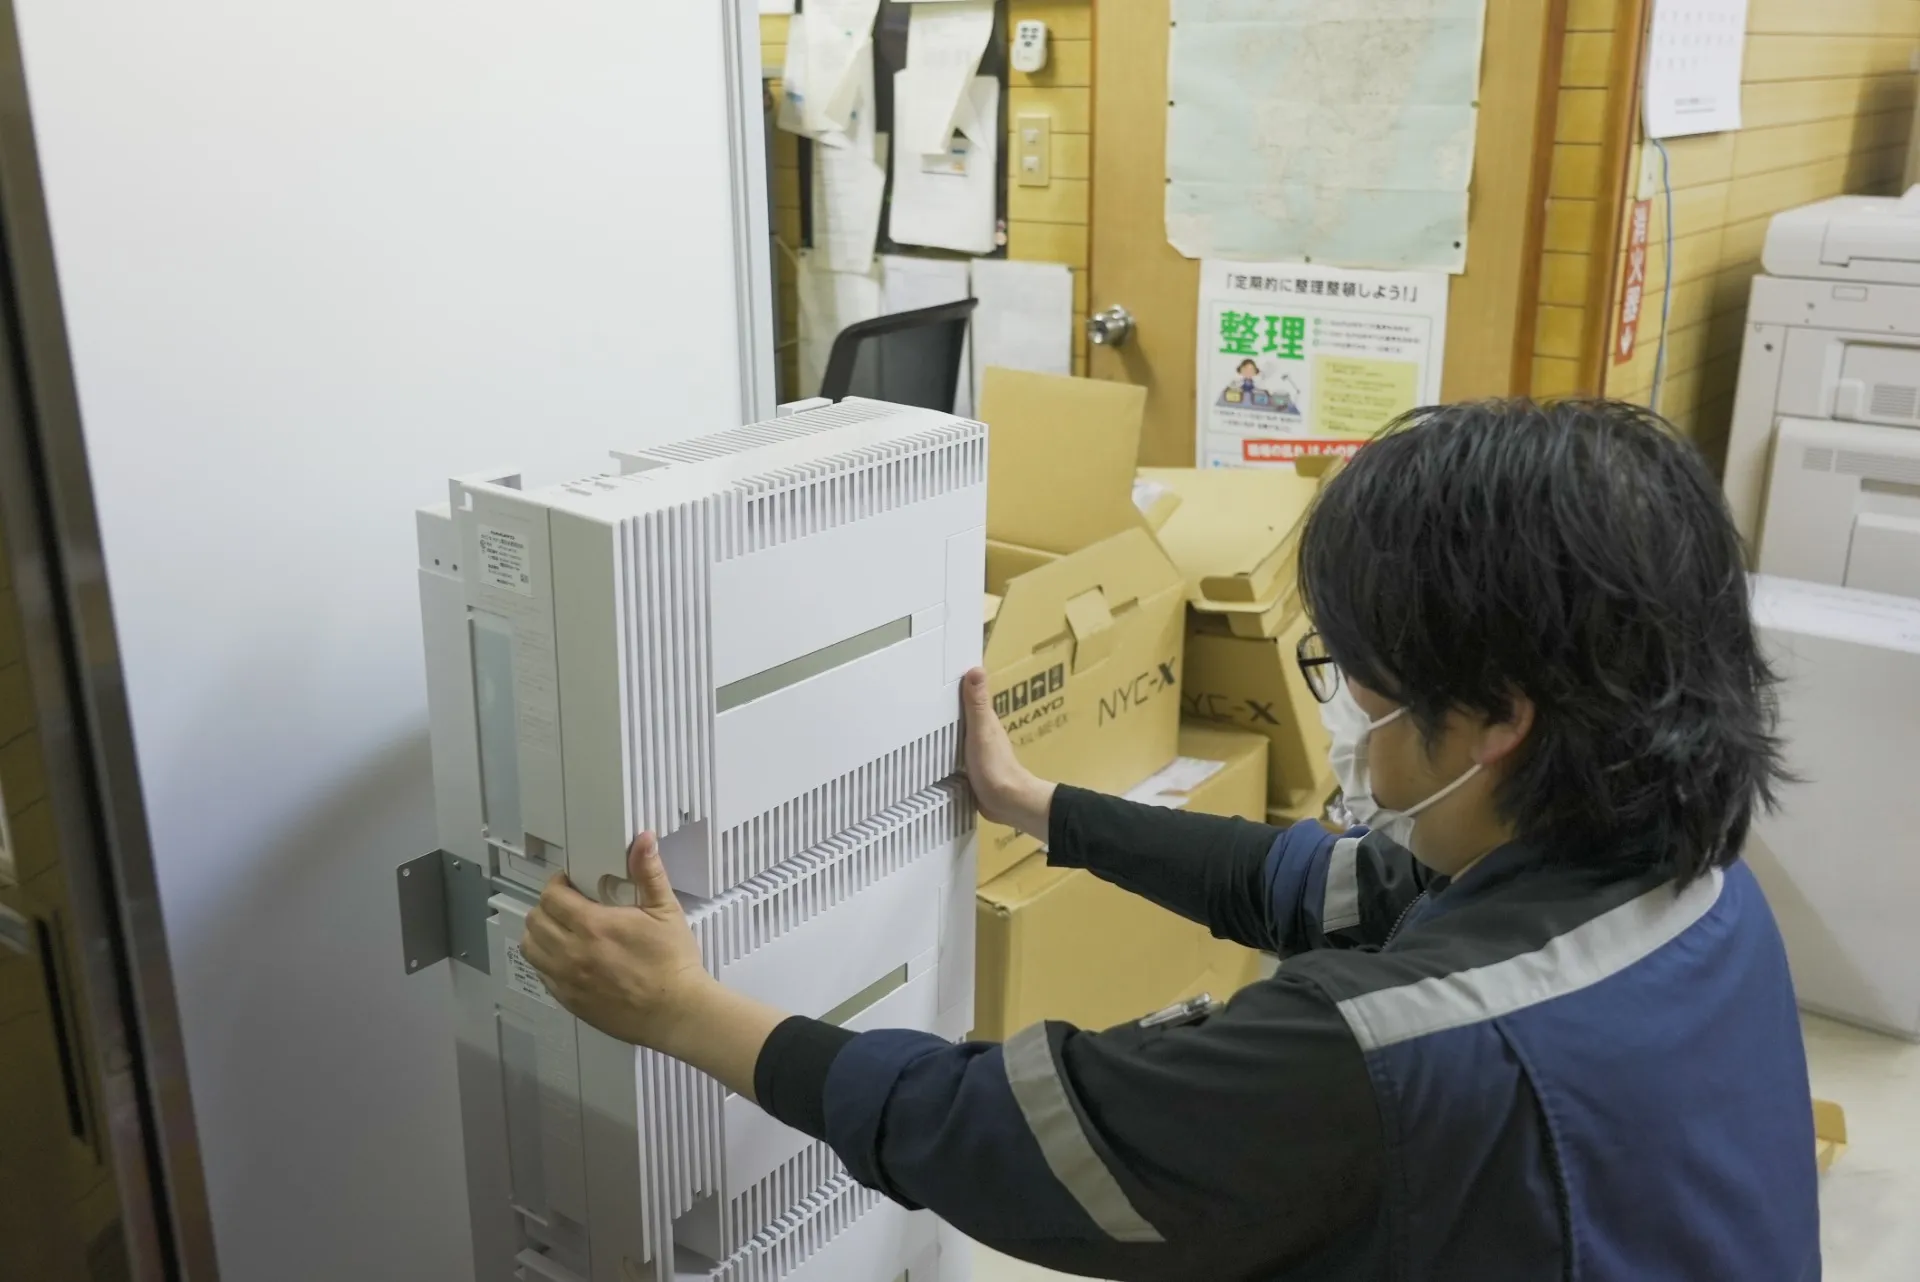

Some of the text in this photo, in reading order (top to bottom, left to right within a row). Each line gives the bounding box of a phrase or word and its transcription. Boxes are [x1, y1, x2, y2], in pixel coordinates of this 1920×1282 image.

[1218, 309, 1306, 361] 整理
[1003, 696, 1065, 734] AKAYO
[1098, 656, 1176, 728] NYC-X
